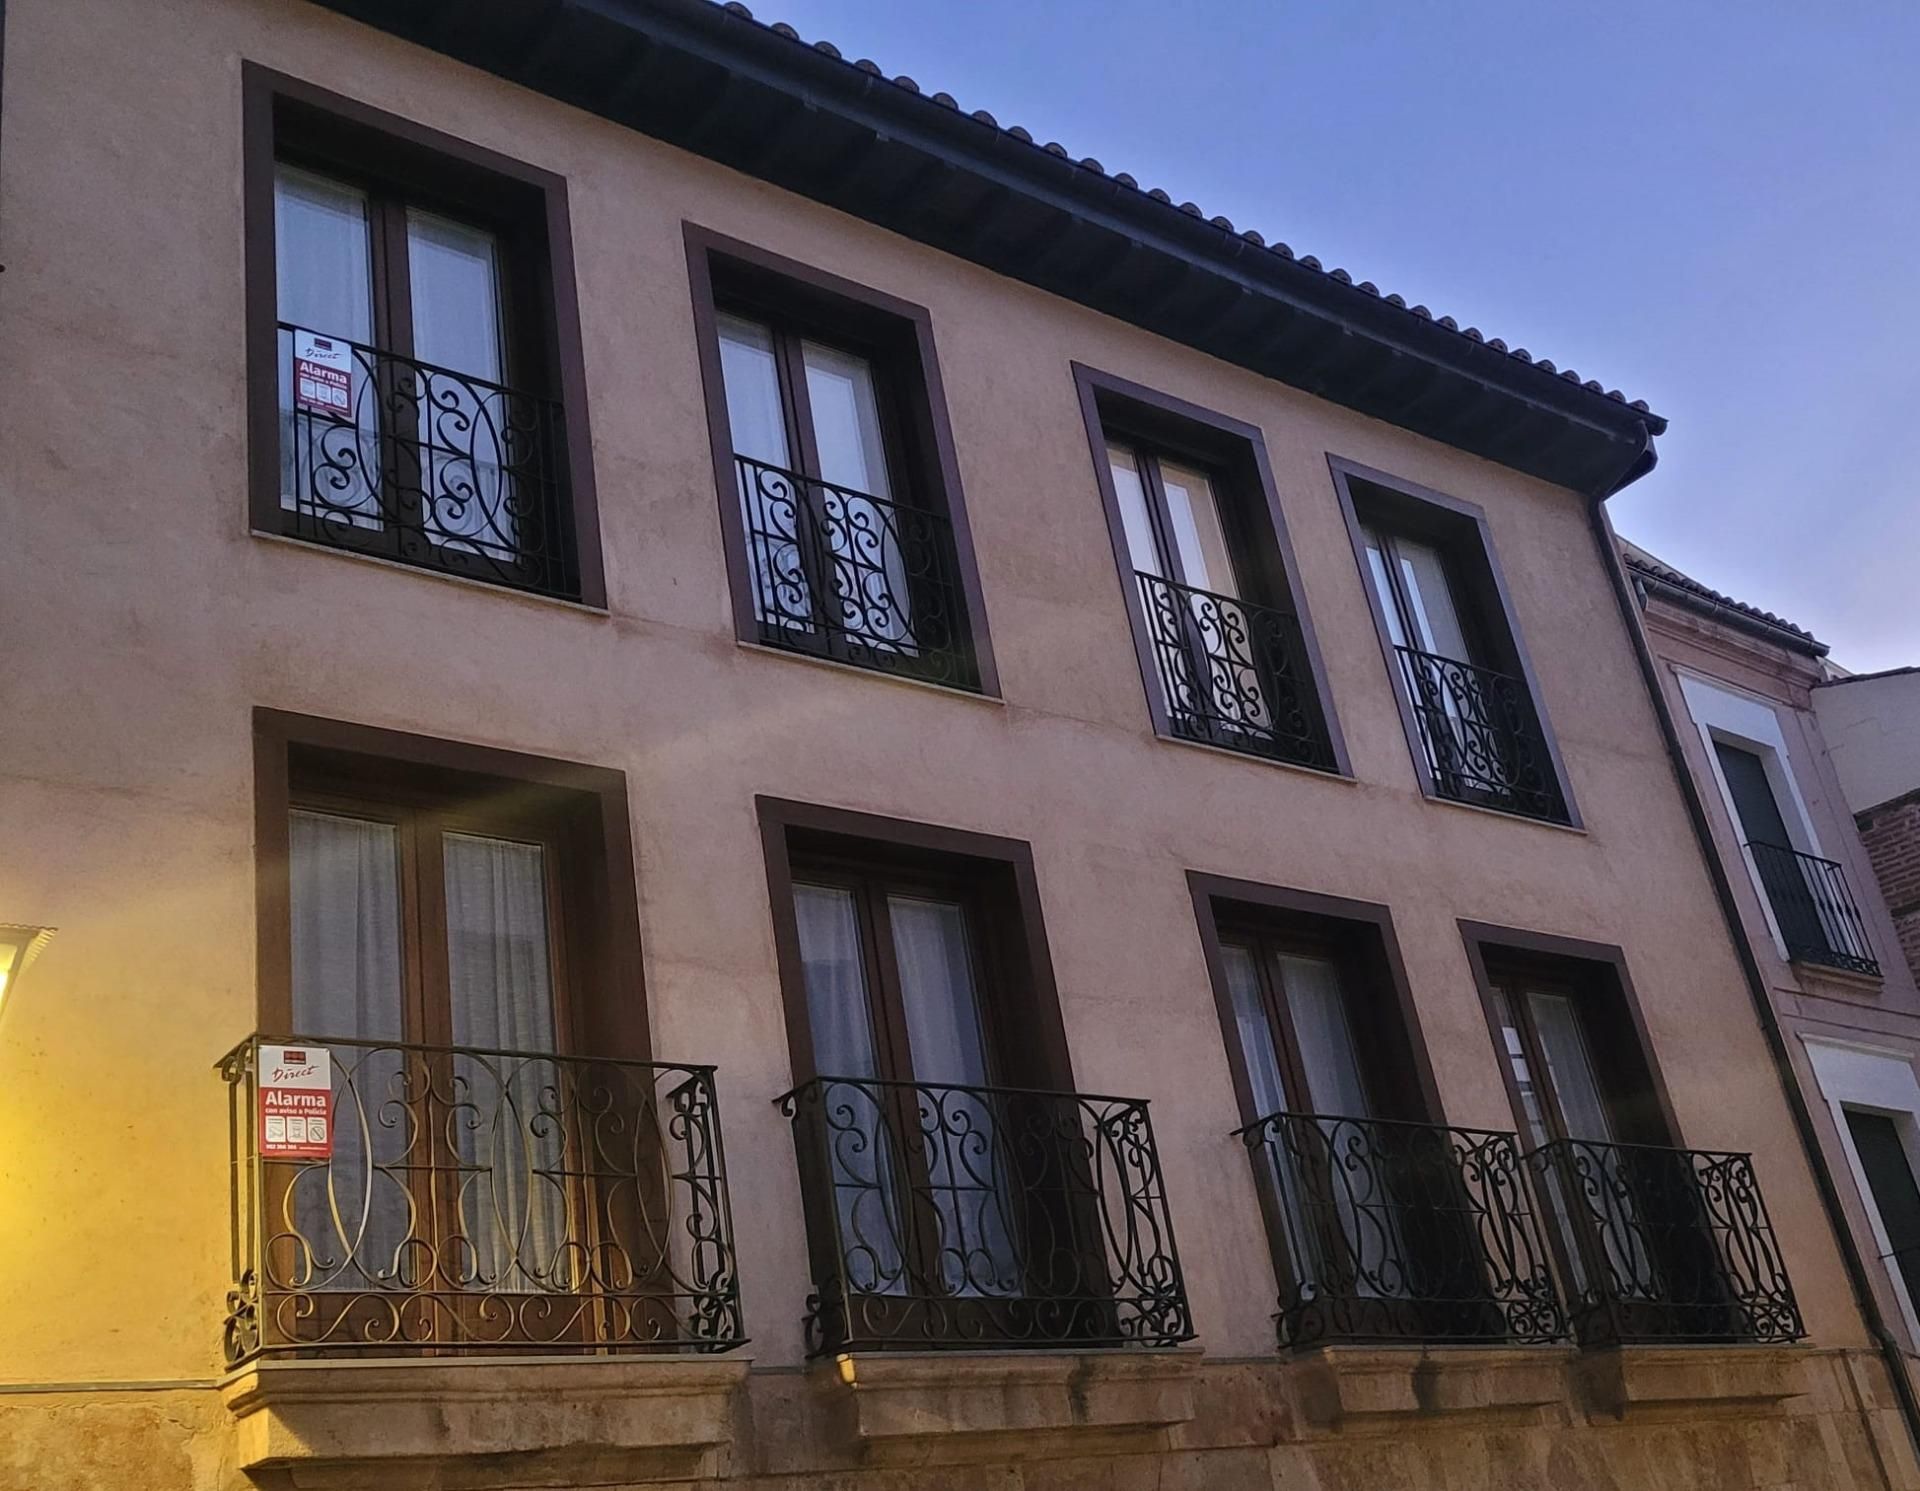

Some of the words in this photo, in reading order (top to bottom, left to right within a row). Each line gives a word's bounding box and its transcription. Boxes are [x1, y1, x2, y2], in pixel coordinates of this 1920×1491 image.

[300, 361, 347, 384] Alarma
[272, 1065, 320, 1082] Direct
[265, 1090, 326, 1107] Alarma
